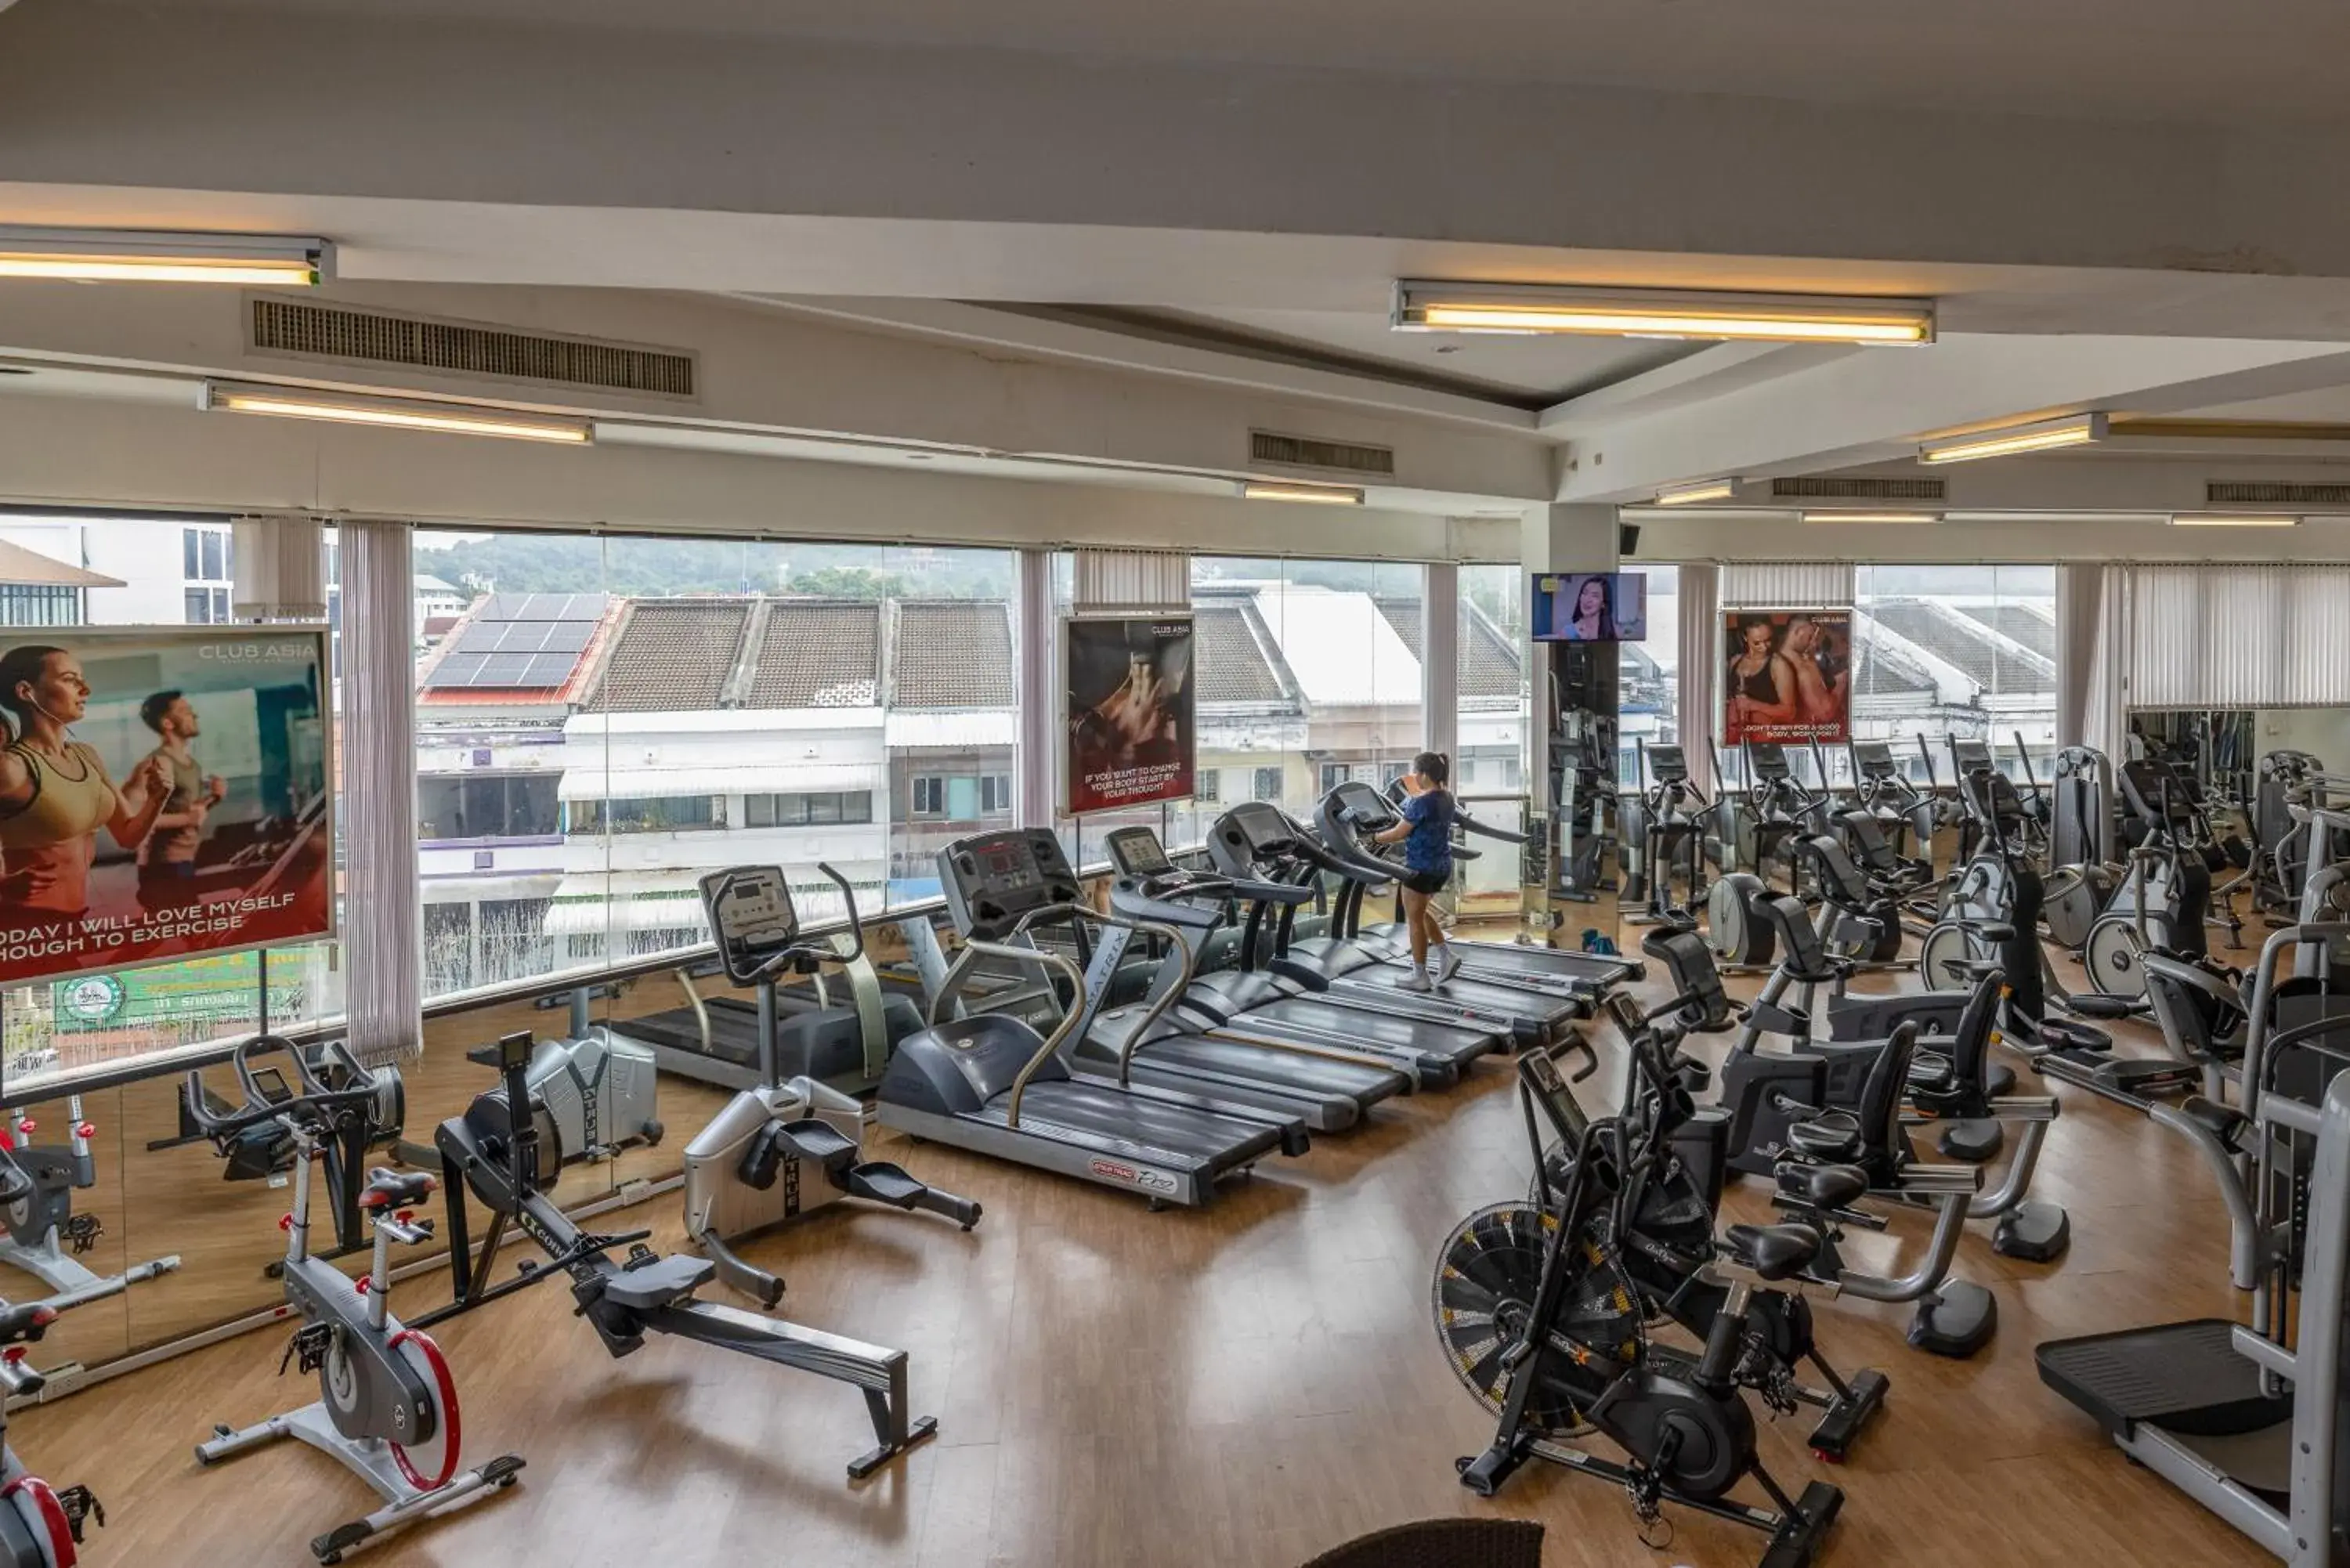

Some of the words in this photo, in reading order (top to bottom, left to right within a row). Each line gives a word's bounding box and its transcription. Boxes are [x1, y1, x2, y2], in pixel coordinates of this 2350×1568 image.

[198, 645, 259, 659] CLUB
[265, 644, 316, 658] ASIA
[1085, 775, 1093, 783] IF
[1095, 772, 1112, 782] YOU
[1090, 781, 1114, 791] YOUR
[1115, 777, 1137, 787] BODY
[1138, 774, 1162, 784] START
[1104, 788, 1126, 798] YOUR
[67, 922, 73, 936] I
[79, 912, 136, 933] WILL
[143, 905, 202, 925] LOVE
[209, 892, 295, 918] MYSELF
[91, 930, 125, 948] TO
[132, 915, 244, 943] EXERCISE
[1086, 932, 1125, 1011] MATRIX
